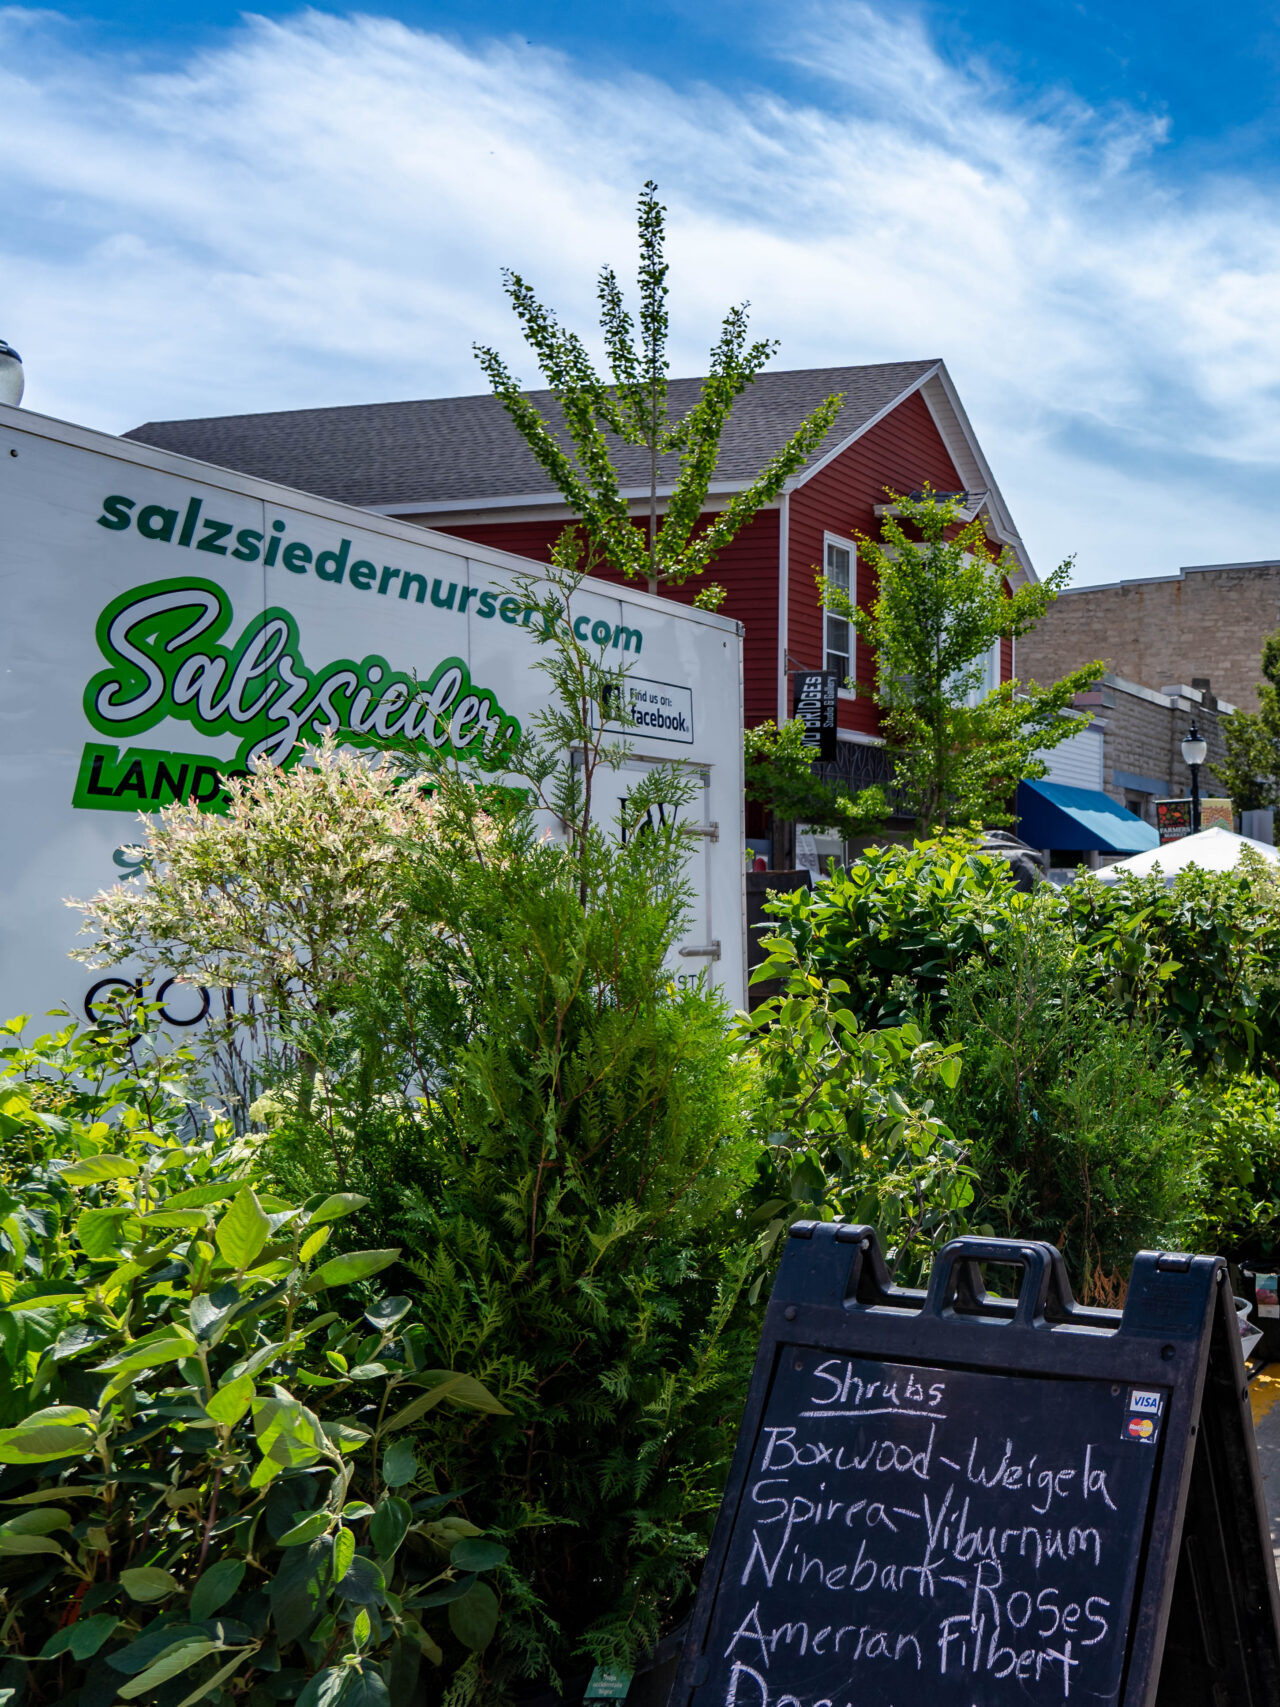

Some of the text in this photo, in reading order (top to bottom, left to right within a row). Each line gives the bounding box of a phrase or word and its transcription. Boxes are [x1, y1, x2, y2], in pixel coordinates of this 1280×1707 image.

[96, 588, 514, 772] Salzsieder
[630, 688, 647, 702] Find
[649, 693, 658, 704] us
[824, 676, 838, 699] Gallery
[795, 676, 822, 728] BRIDGES
[823, 707, 834, 728] Studio
[811, 1359, 946, 1407] Shrubs
[1134, 1396, 1157, 1408] VISA
[937, 1613, 1079, 1698] Filbert
